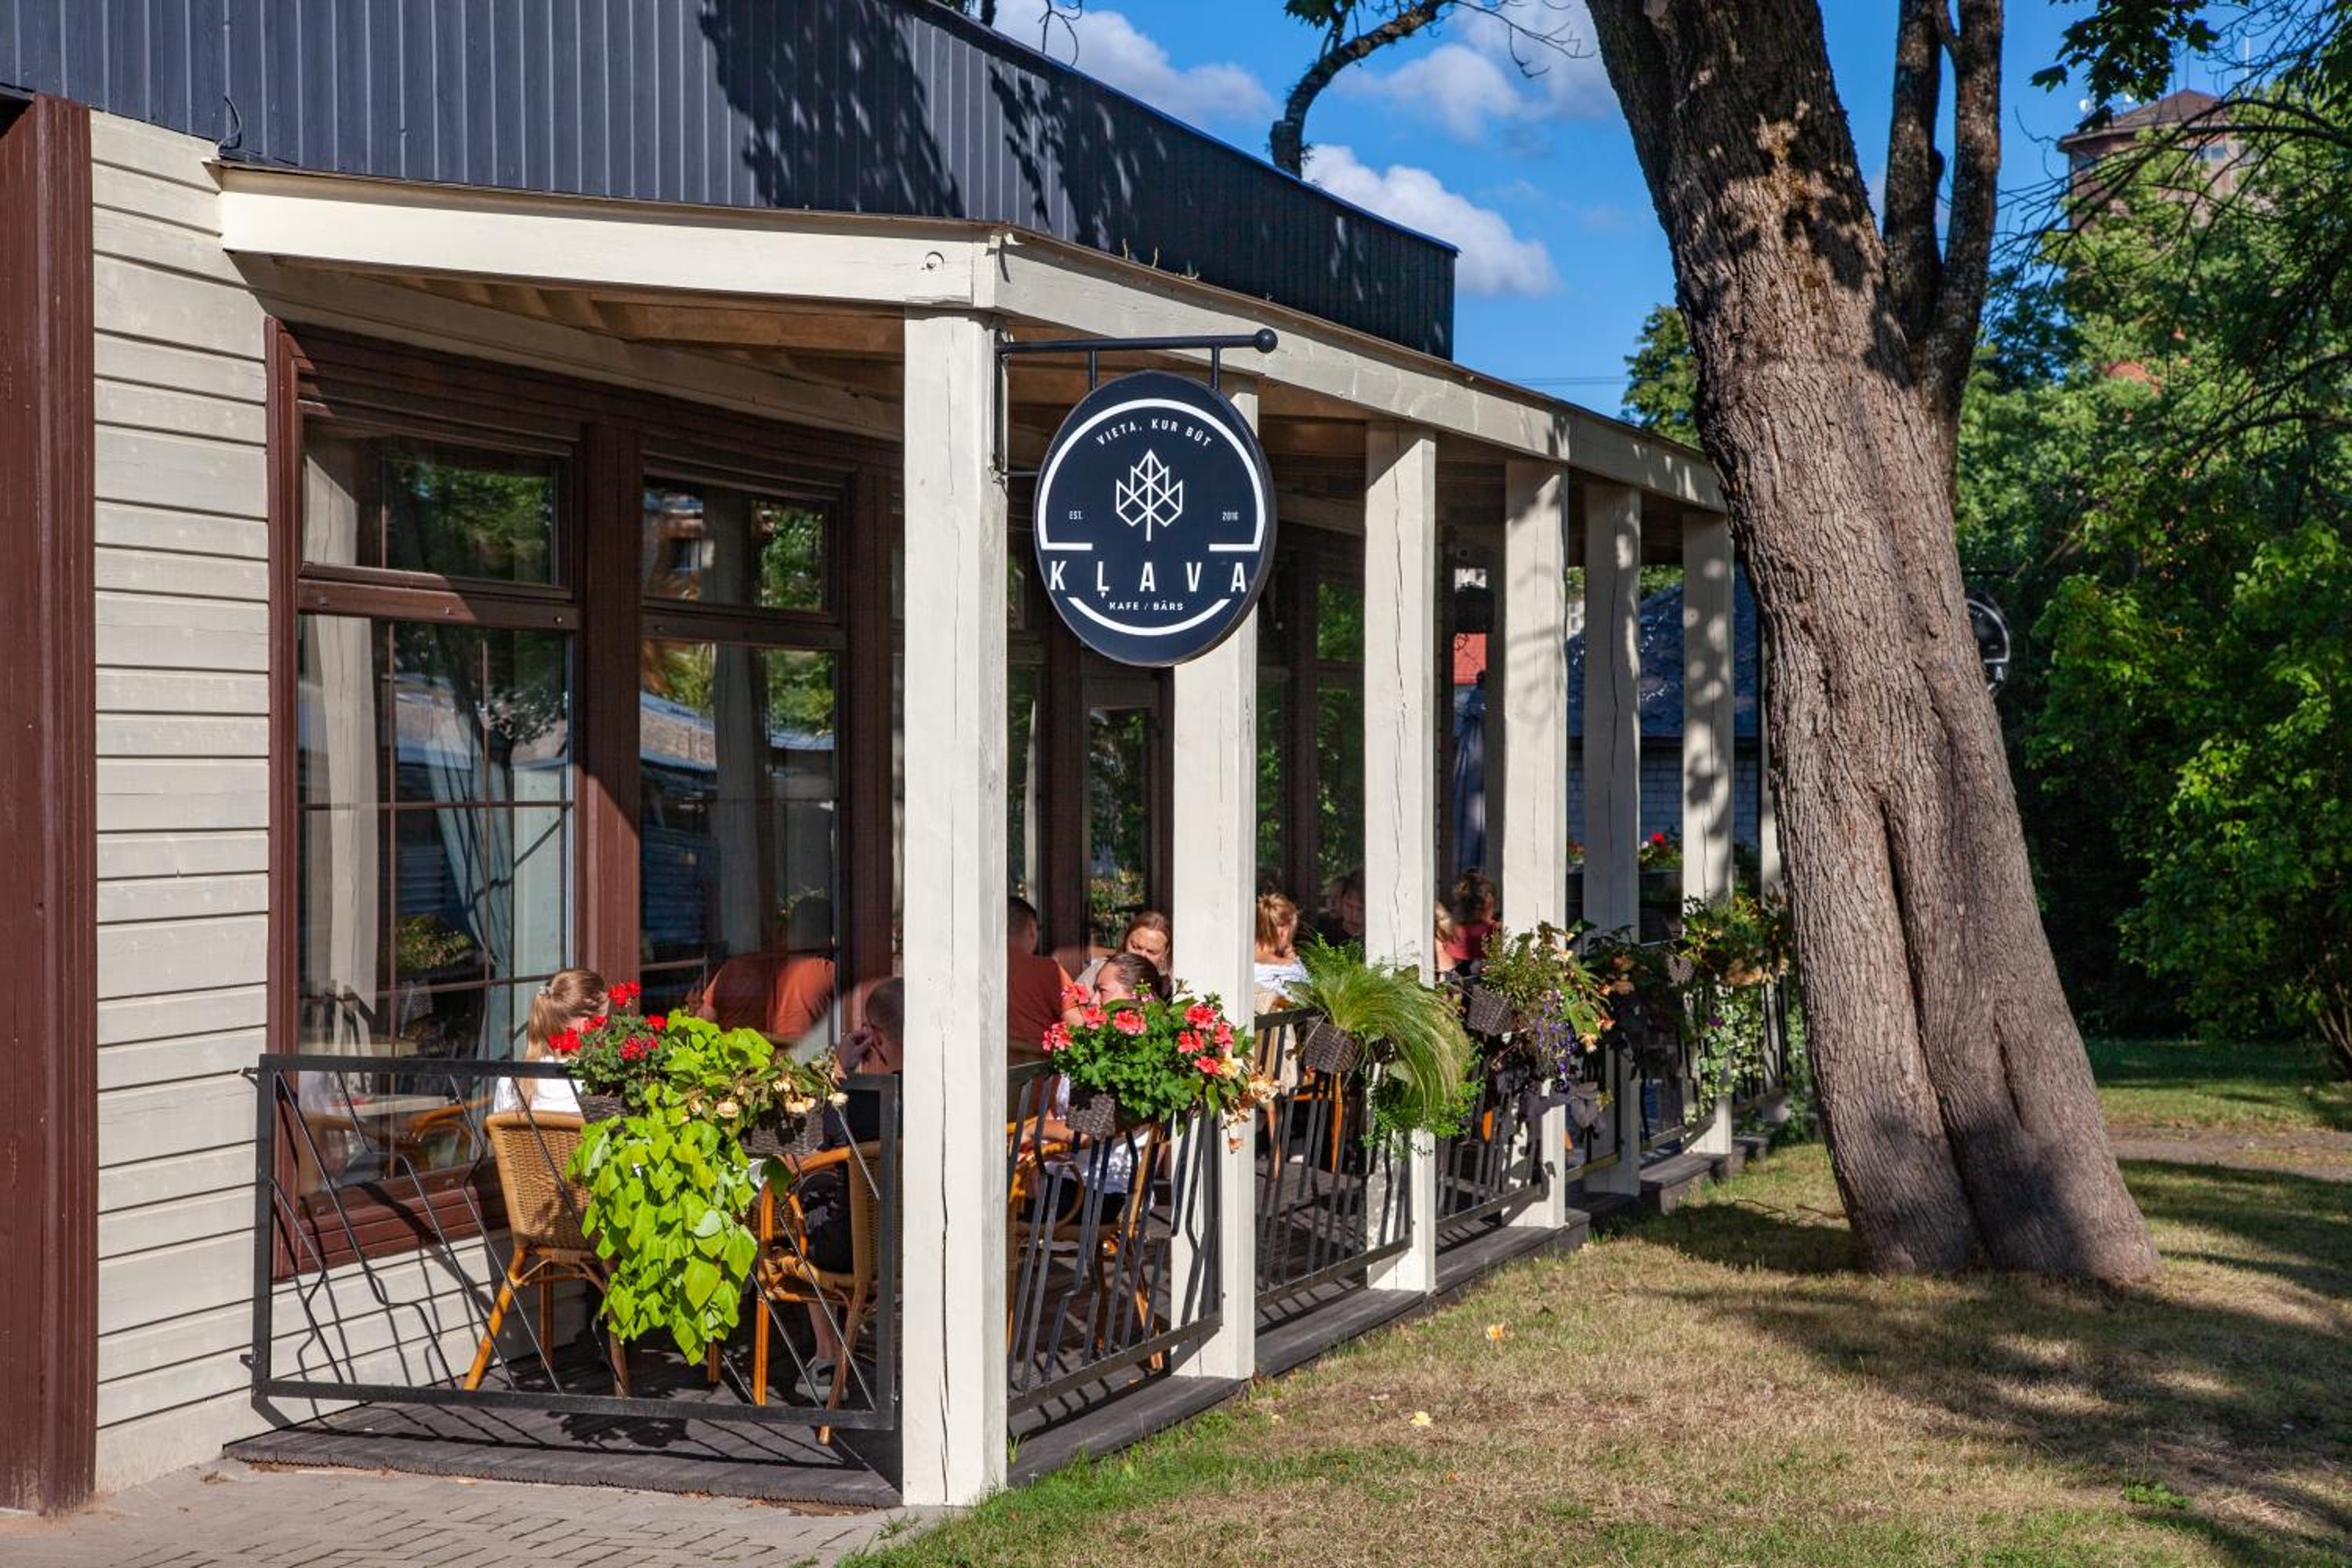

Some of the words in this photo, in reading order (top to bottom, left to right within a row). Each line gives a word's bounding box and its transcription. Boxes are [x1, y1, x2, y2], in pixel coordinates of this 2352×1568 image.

[1151, 419, 1178, 432] KUR
[1050, 561, 1247, 599] KĻAVA
[1109, 601, 1139, 611] KAFE
[1153, 600, 1184, 611] BĀRS
